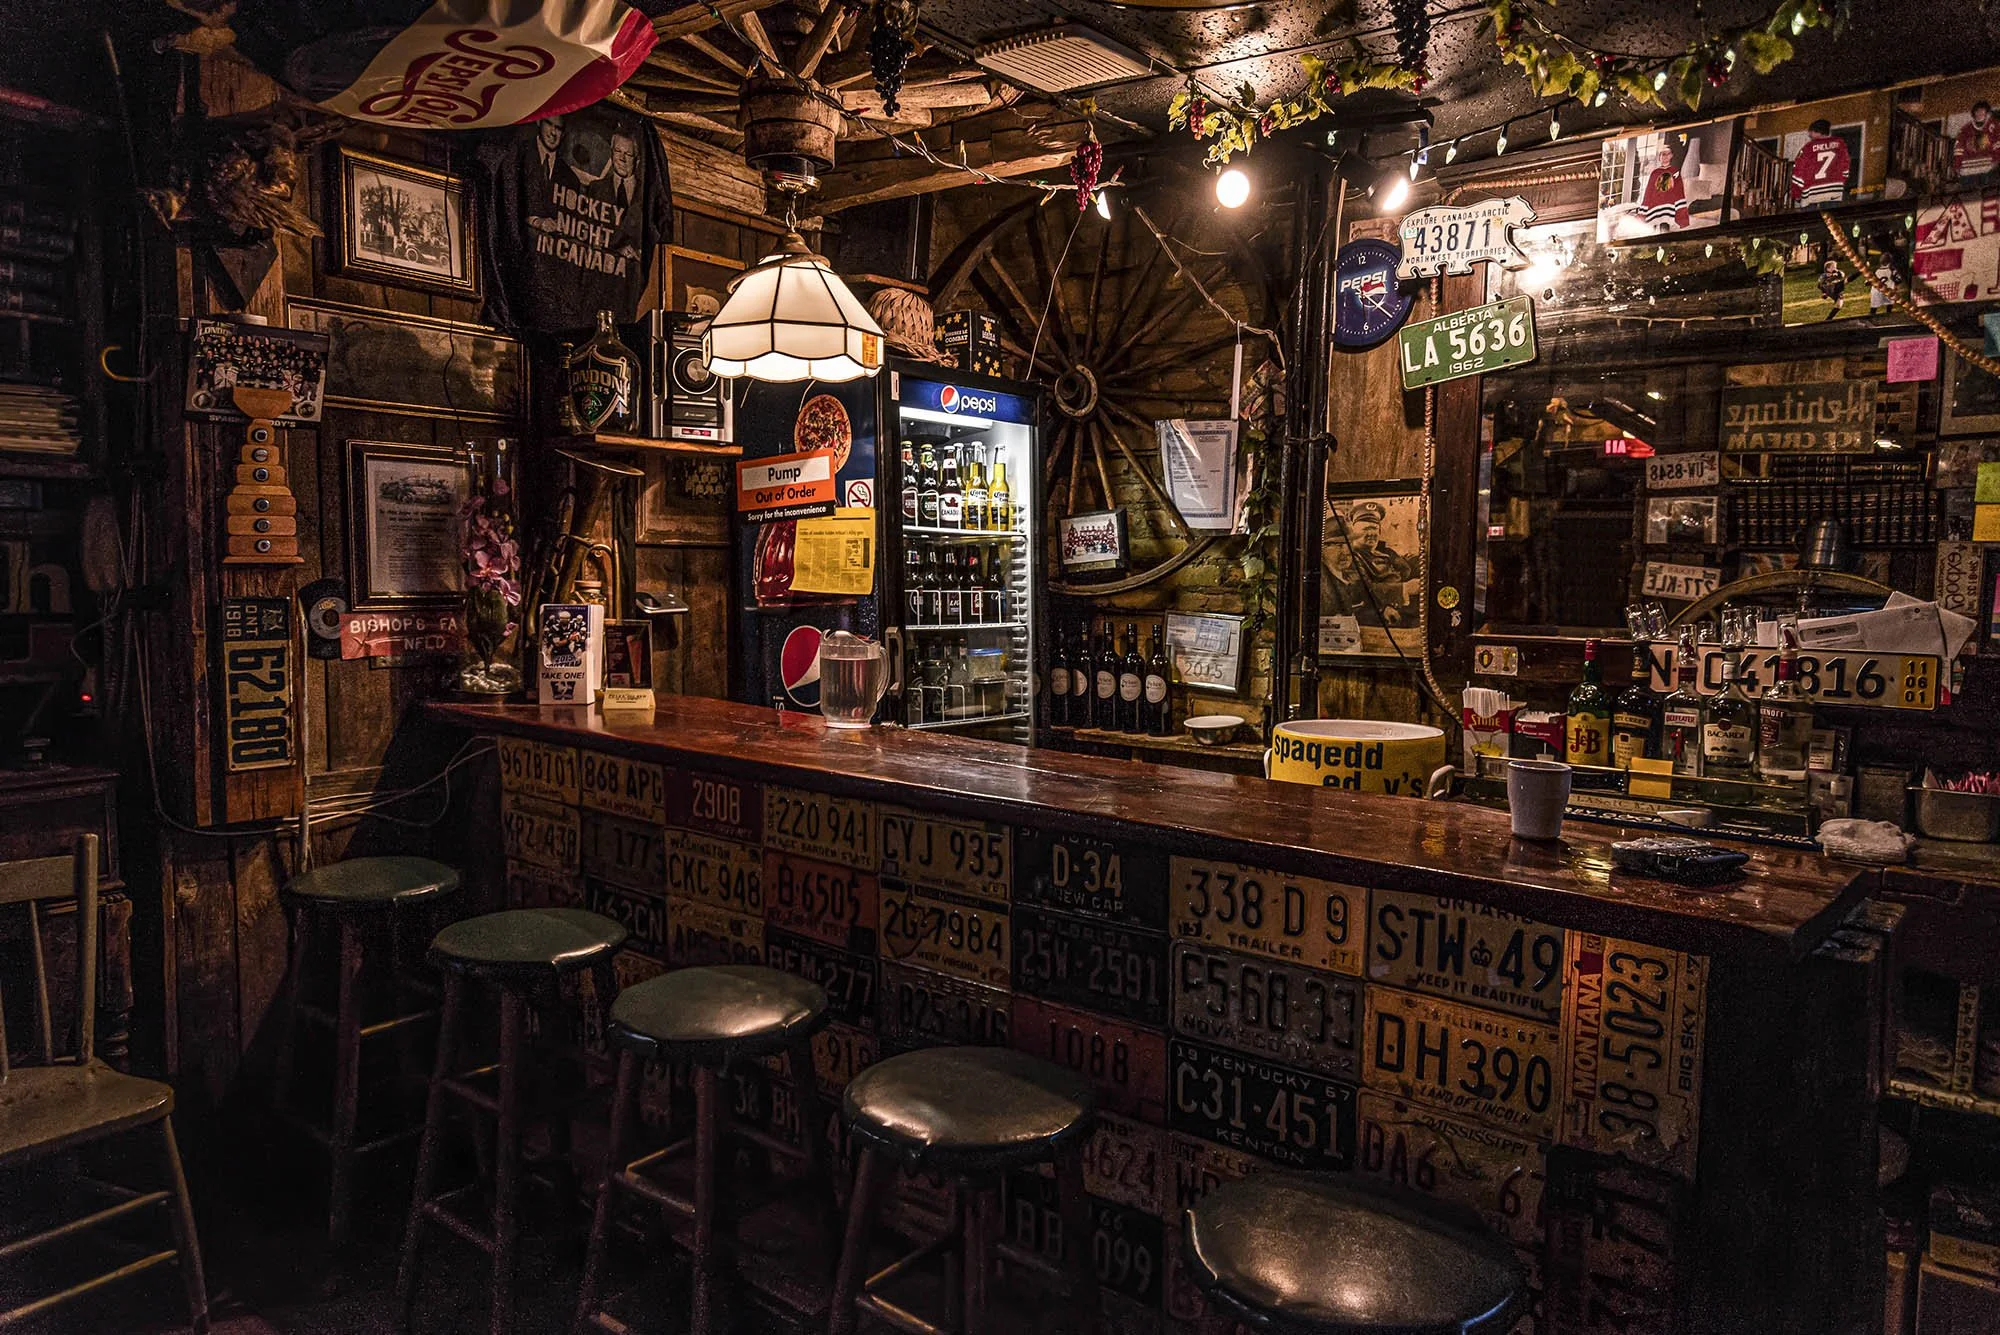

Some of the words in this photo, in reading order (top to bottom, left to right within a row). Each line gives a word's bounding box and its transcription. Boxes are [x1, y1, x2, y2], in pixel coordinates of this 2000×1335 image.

[1814, 151, 1836, 180] 7
[552, 183, 625, 227] HOCKEY
[1406, 216, 1437, 228] EXPLORE
[1442, 210, 1480, 222] CANADA'S
[1481, 206, 1510, 217] ARCTIC
[556, 211, 615, 248] NIGHT
[1413, 219, 1492, 256] 43871
[536, 233, 555, 256] IN
[556, 238, 627, 278] CANADA
[1358, 255, 1366, 265] 12
[1406, 252, 1453, 265] NORTHWEST
[1455, 247, 1507, 259] TERRITORIES
[1340, 270, 1387, 293] PEPSI
[1393, 281, 1399, 290] 3
[1363, 321, 1369, 331] 6
[1433, 310, 1494, 333] ALBERTA
[1404, 336, 1439, 372] LA
[1450, 312, 1527, 360] 5636
[1449, 357, 1486, 374] 1962
[960, 396, 997, 413] pepsi
[768, 467, 801, 482] Pump
[756, 490, 773, 503] Out
[775, 488, 784, 501] of
[787, 485, 816, 499] Order
[747, 513, 764, 522] Sorry
[764, 510, 774, 520] for
[774, 509, 783, 518] the
[784, 505, 827, 517] inconvenience
[245, 605, 259, 637] ONT
[404, 636, 447, 650] NFLD
[563, 672, 585, 680] ONE!
[1184, 660, 1224, 679] 2015
[1907, 660, 1927, 675] 11
[1904, 690, 1926, 704] 01
[1905, 676, 1928, 689] 06
[229, 646, 288, 764] 62180
[1666, 714, 1696, 723] BEEFEATER
[1570, 727, 1600, 755] J&B
[1706, 730, 1745, 740] BACARDI
[584, 756, 619, 793] 868
[691, 779, 741, 825] 2908
[776, 797, 820, 841] 220
[827, 807, 869, 853] 941
[883, 817, 933, 867] CYJ
[950, 831, 1004, 879] 935
[669, 853, 710, 895] CKC
[718, 864, 761, 908] 948
[1057, 888, 1086, 906] NEW
[1091, 896, 1124, 914] CAR
[1189, 869, 1263, 929] 338
[1284, 886, 1305, 936] D
[1326, 894, 1348, 945] 9
[1046, 919, 1131, 948] FLORIDA
[1227, 932, 1303, 959] TRAILER
[916, 950, 940, 964] WEST
[942, 956, 979, 974] VIRGINIA
[1498, 928, 1561, 993] 49
[1416, 971, 1450, 989] KEEP
[1454, 979, 1466, 994] IT
[1472, 985, 1546, 1012] BEAUTIFUL
[1445, 1014, 1509, 1039] ILLINOIS
[1517, 1030, 1538, 1045] 67
[1573, 973, 1602, 1100] MONTANA
[1680, 1003, 1696, 1051] SKY
[1210, 1052, 1311, 1091] KENTUCKY
[1325, 1083, 1351, 1101] 67
[1375, 1012, 1450, 1086] DH
[1459, 1039, 1552, 1113] 390
[1679, 1055, 1693, 1092] BIG
[1420, 1085, 1453, 1103] LAND
[1454, 1094, 1470, 1108] OF
[1474, 1098, 1532, 1125] LINCOLN
[1216, 1127, 1305, 1165] KENTON
[1422, 1114, 1528, 1157] MISSISSIPPI
